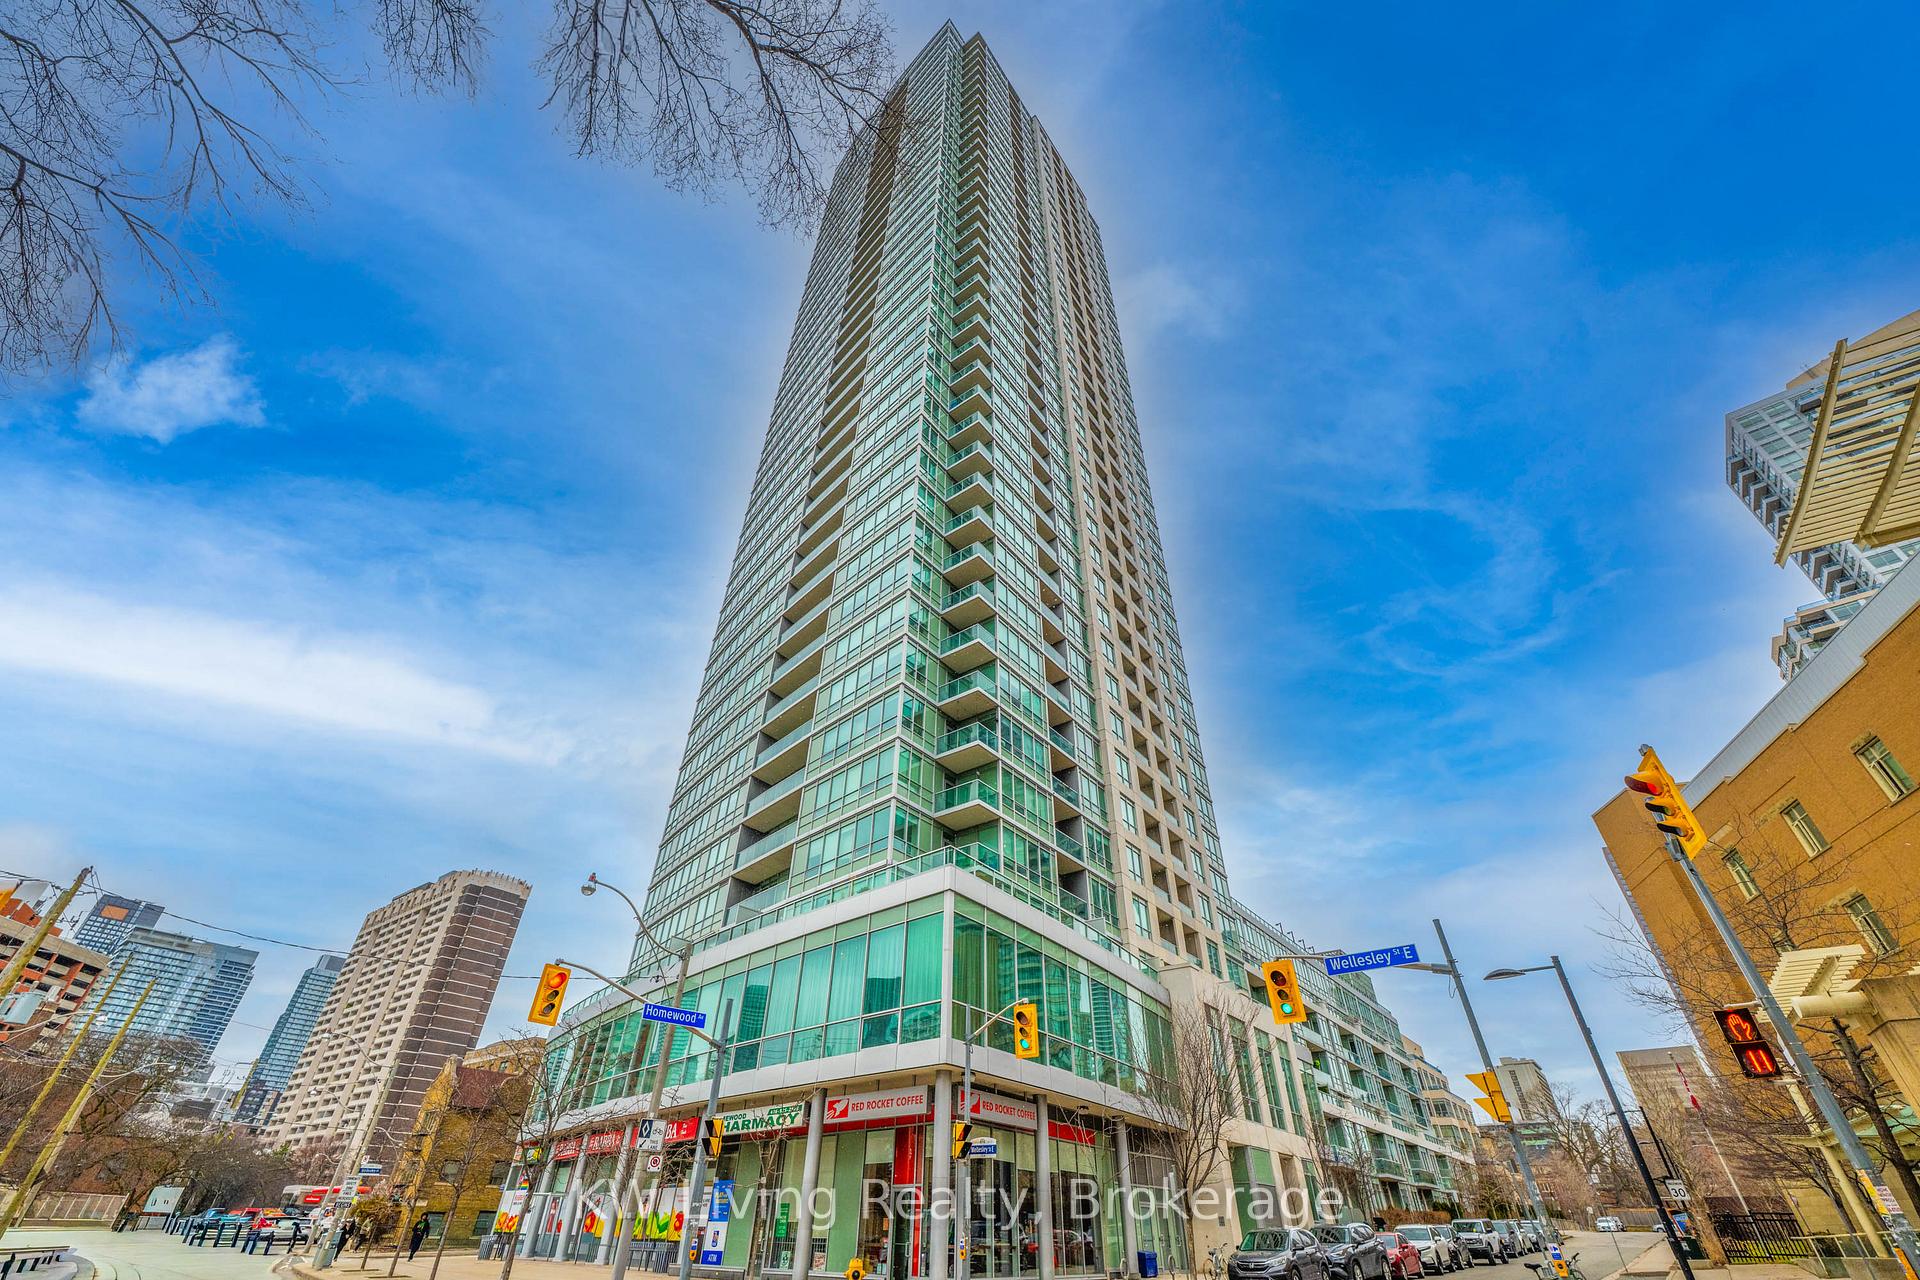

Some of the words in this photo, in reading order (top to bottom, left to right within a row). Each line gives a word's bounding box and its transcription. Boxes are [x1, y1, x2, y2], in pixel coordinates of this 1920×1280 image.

[1329, 951, 1391, 971] Wellesley
[1403, 946, 1413, 959] E
[645, 1004, 697, 1023] Homewood
[851, 1102, 865, 1112] RED
[866, 1098, 894, 1110] ROCKET
[896, 1094, 924, 1107] COFFEE
[982, 1100, 994, 1112] RED
[995, 1103, 1017, 1116] ROCKET
[1017, 1109, 1036, 1120] COFFEE
[723, 1112, 799, 1132] HARMACY
[1670, 1187, 1686, 1198] 30
